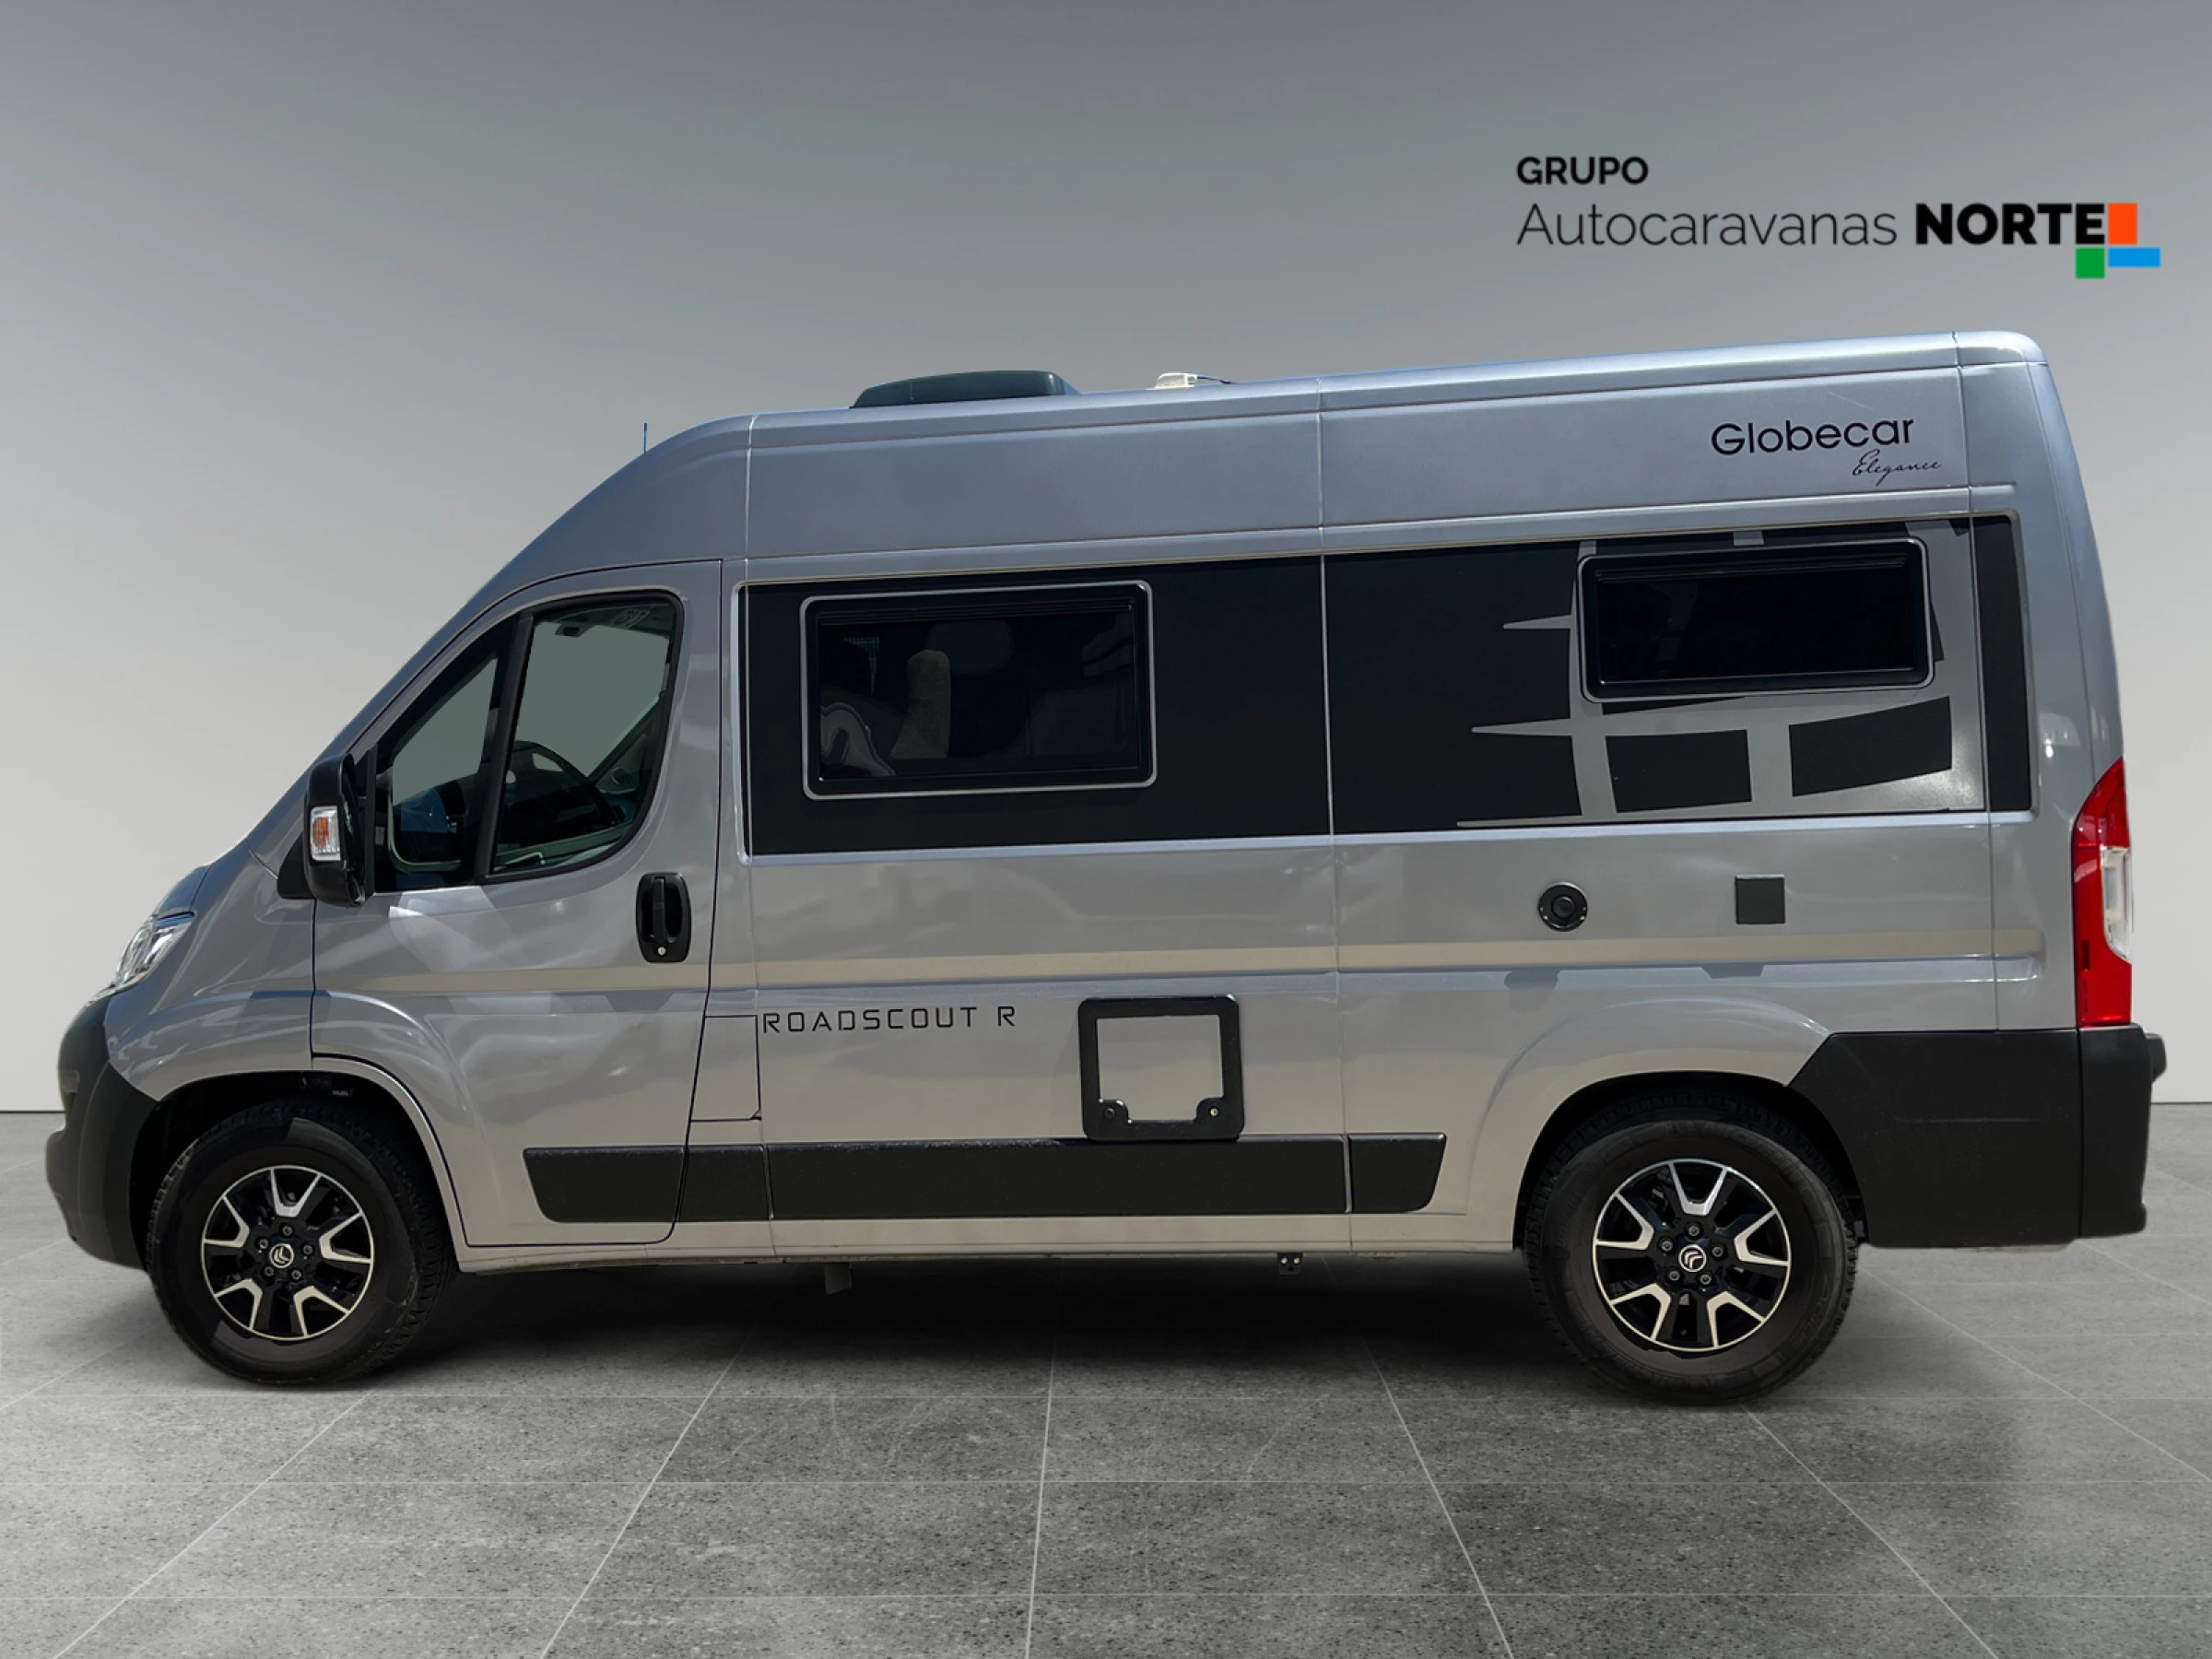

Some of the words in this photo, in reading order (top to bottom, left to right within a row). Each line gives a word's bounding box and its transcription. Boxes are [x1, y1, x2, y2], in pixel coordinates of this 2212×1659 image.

[1711, 418, 1914, 455] Globecar
[1852, 449, 1941, 487] Elegance
[762, 1006, 978, 1034] ROADSCOUT
[997, 1006, 1017, 1027] R
